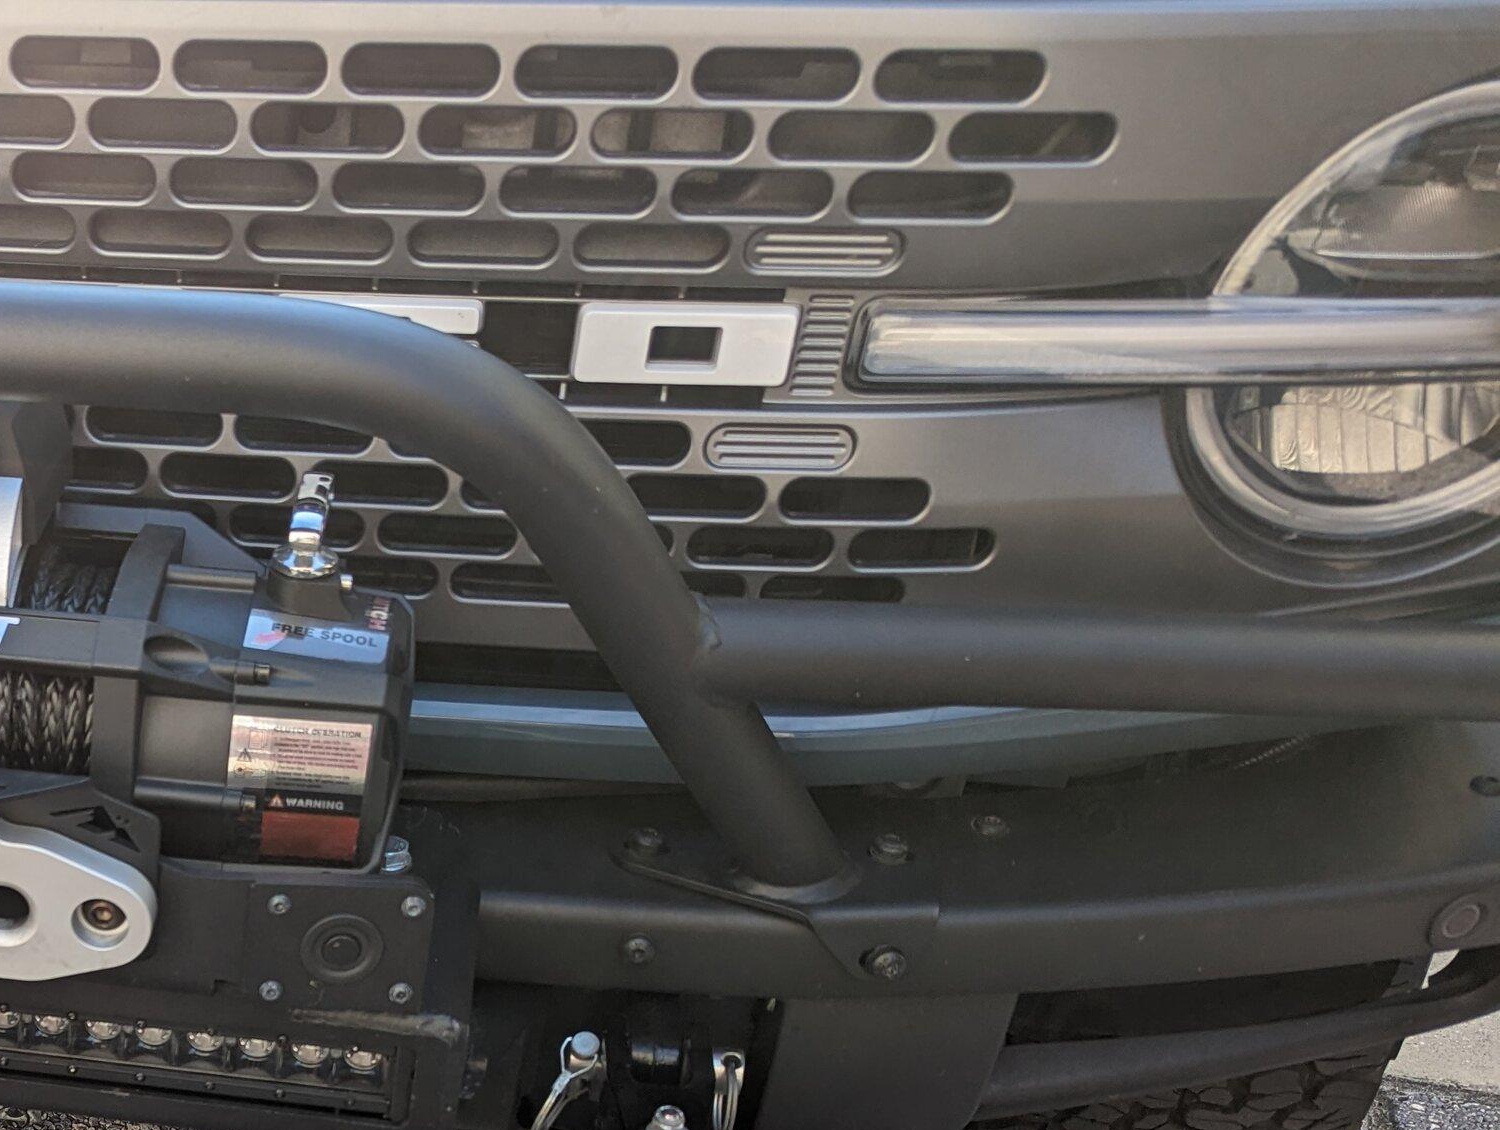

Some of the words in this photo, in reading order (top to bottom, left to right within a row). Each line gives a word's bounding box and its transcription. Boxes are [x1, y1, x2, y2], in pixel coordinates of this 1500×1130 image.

[271, 621, 314, 638] FREE
[320, 628, 378, 648] SPOOL
[286, 797, 345, 811] WARNING
